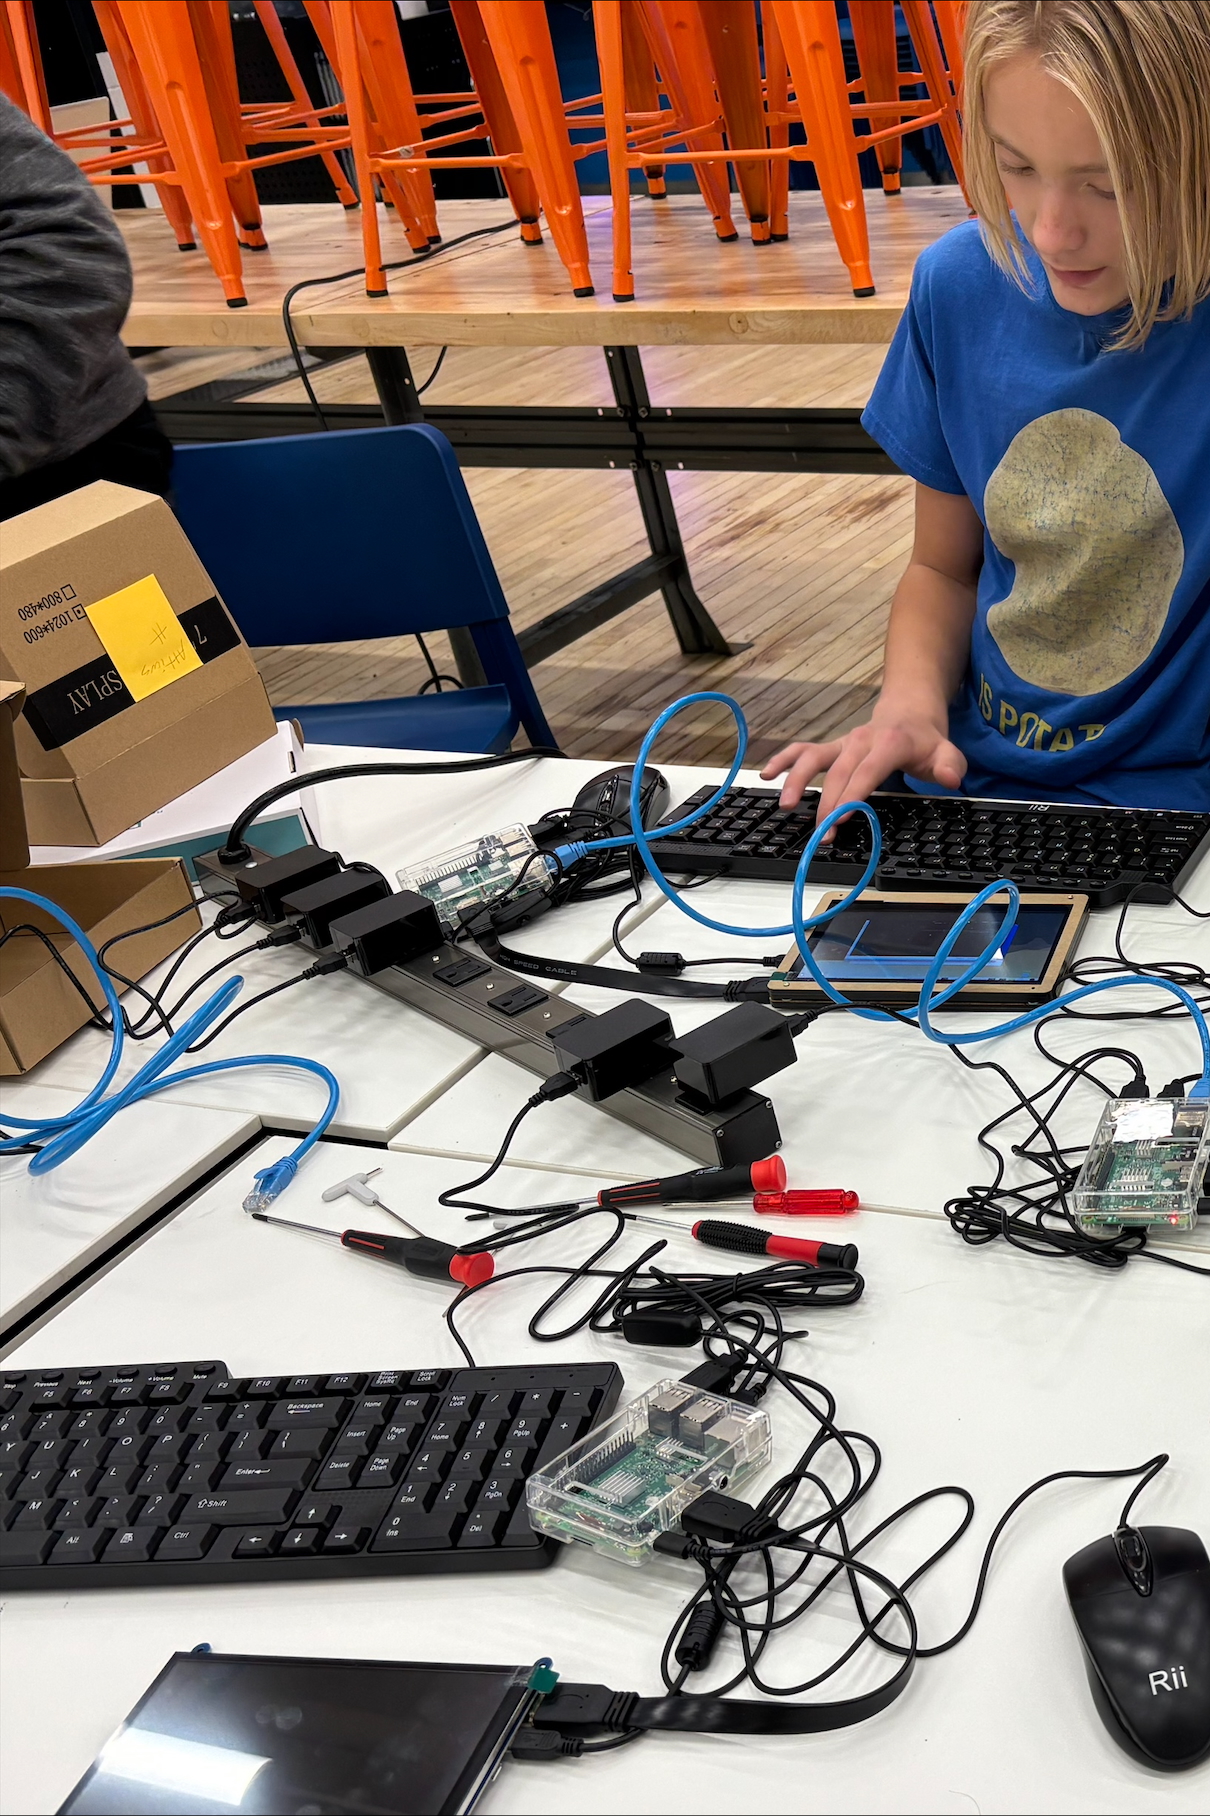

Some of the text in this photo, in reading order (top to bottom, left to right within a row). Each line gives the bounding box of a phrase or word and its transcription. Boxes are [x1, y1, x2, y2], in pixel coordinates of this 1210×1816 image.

[67, 670, 123, 715] SPLAY
[999, 700, 1107, 752] POTAT
[518, 1420, 525, 1428] 9
[162, 1435, 172, 1443] P
[6, 1443, 16, 1451] Y
[44, 1441, 54, 1449] U
[463, 1452, 471, 1460] 5
[505, 1450, 512, 1458] 6
[31, 1471, 41, 1479] J
[70, 1469, 81, 1477] K
[448, 1483, 456, 1491] 2
[490, 1481, 497, 1489] 3
[29, 1502, 42, 1510] M
[1149, 1665, 1188, 1696] Rii
